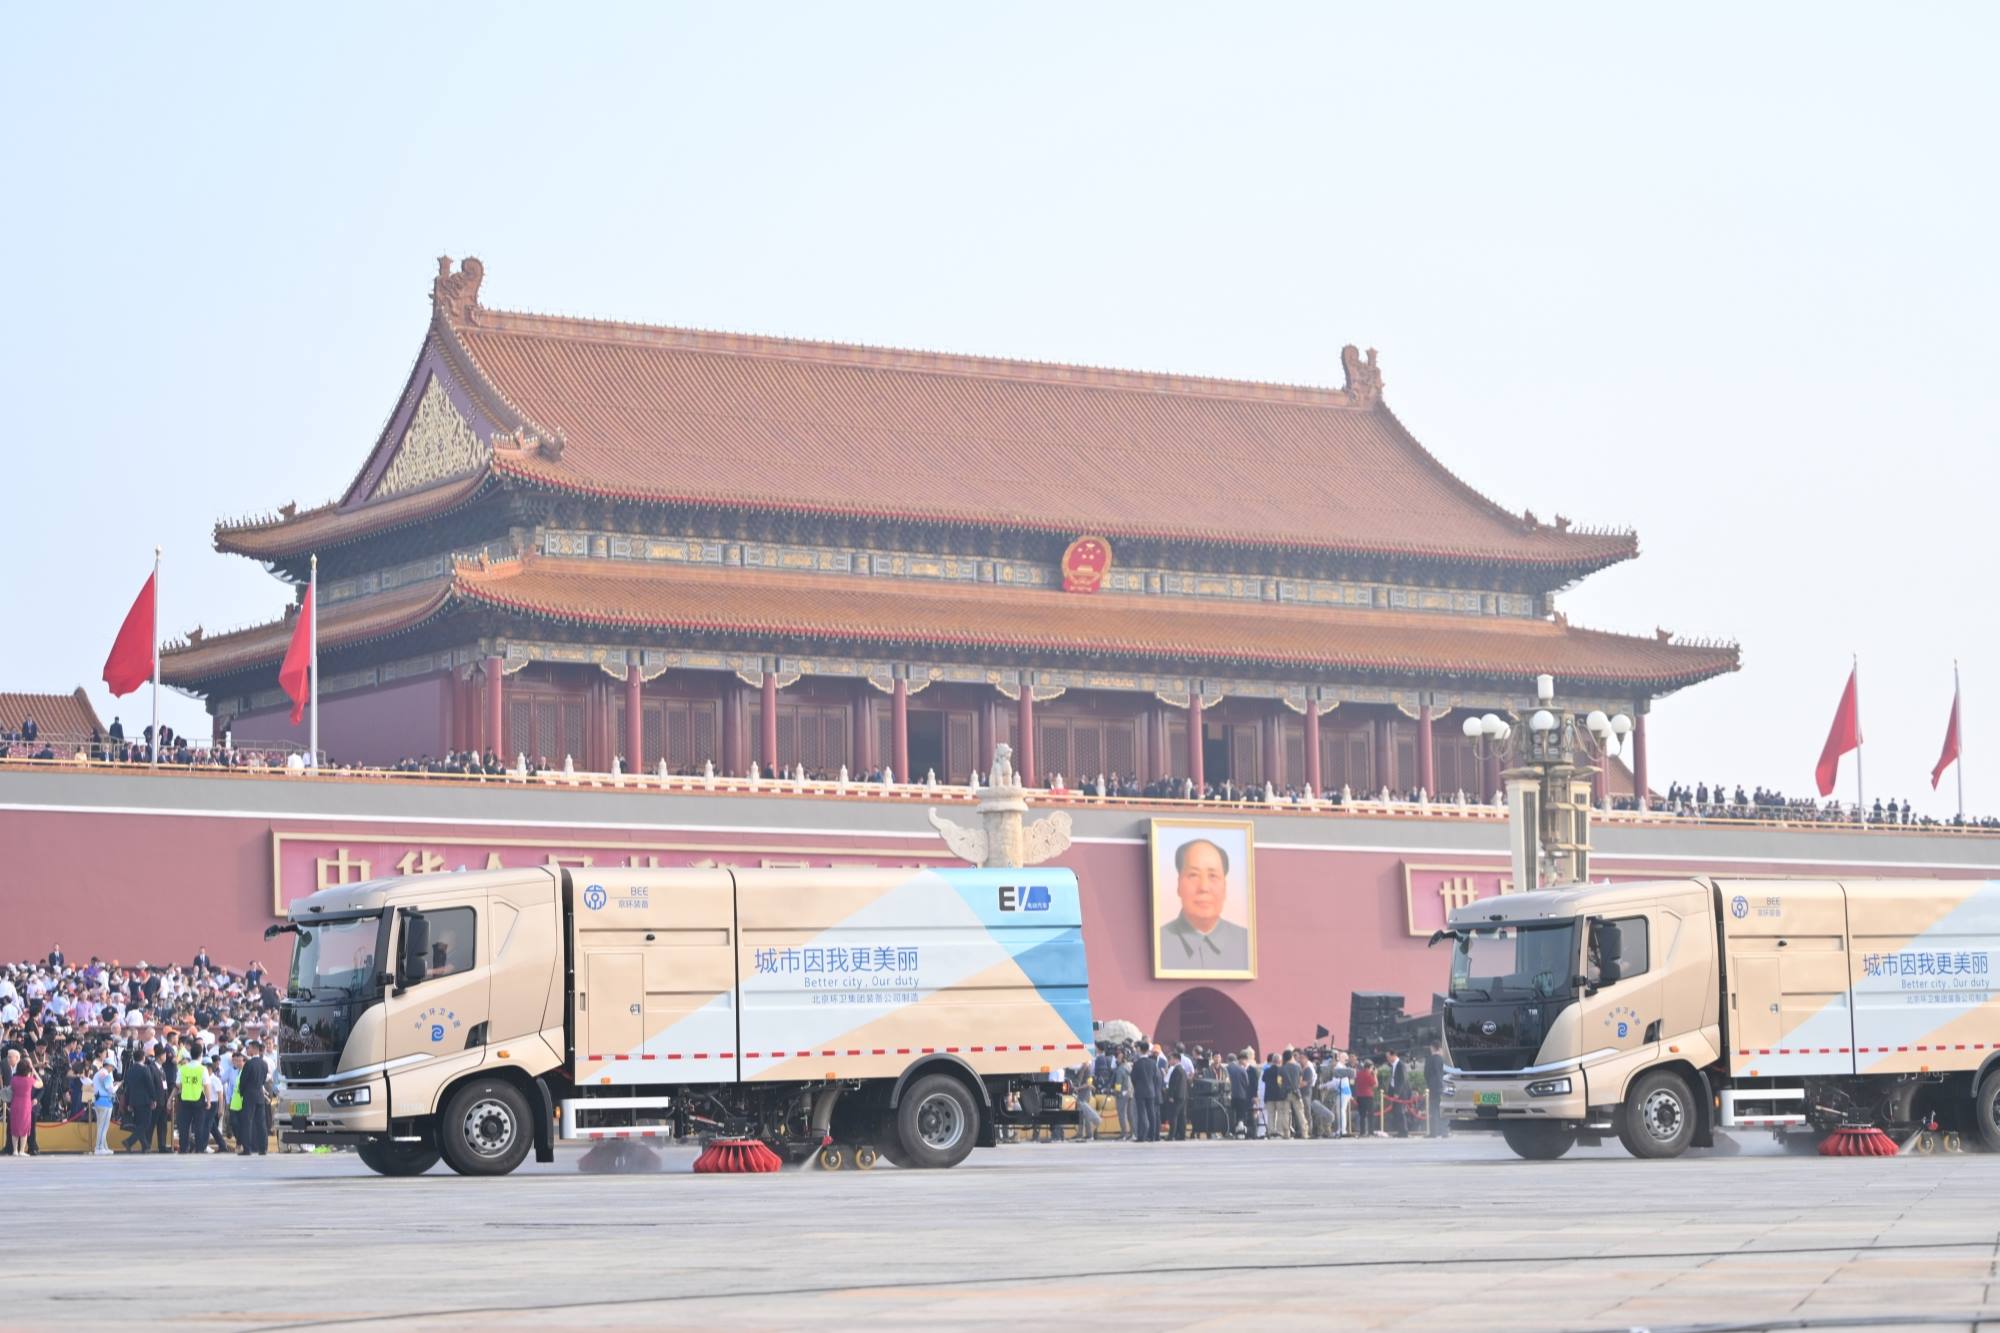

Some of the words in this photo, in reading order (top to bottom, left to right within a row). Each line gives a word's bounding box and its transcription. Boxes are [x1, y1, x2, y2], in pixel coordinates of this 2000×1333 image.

[630, 886, 648, 896] BEE
[754, 946, 919, 974] 城市因我更美丽
[1863, 951, 1988, 976] 城市因我更美丽
[804, 977, 839, 988] Better
[872, 976, 891, 987] Our
[895, 976, 919, 989] duty
[1901, 979, 1927, 989] Better
[1953, 978, 1967, 988] Our
[1971, 978, 1989, 989] duty
